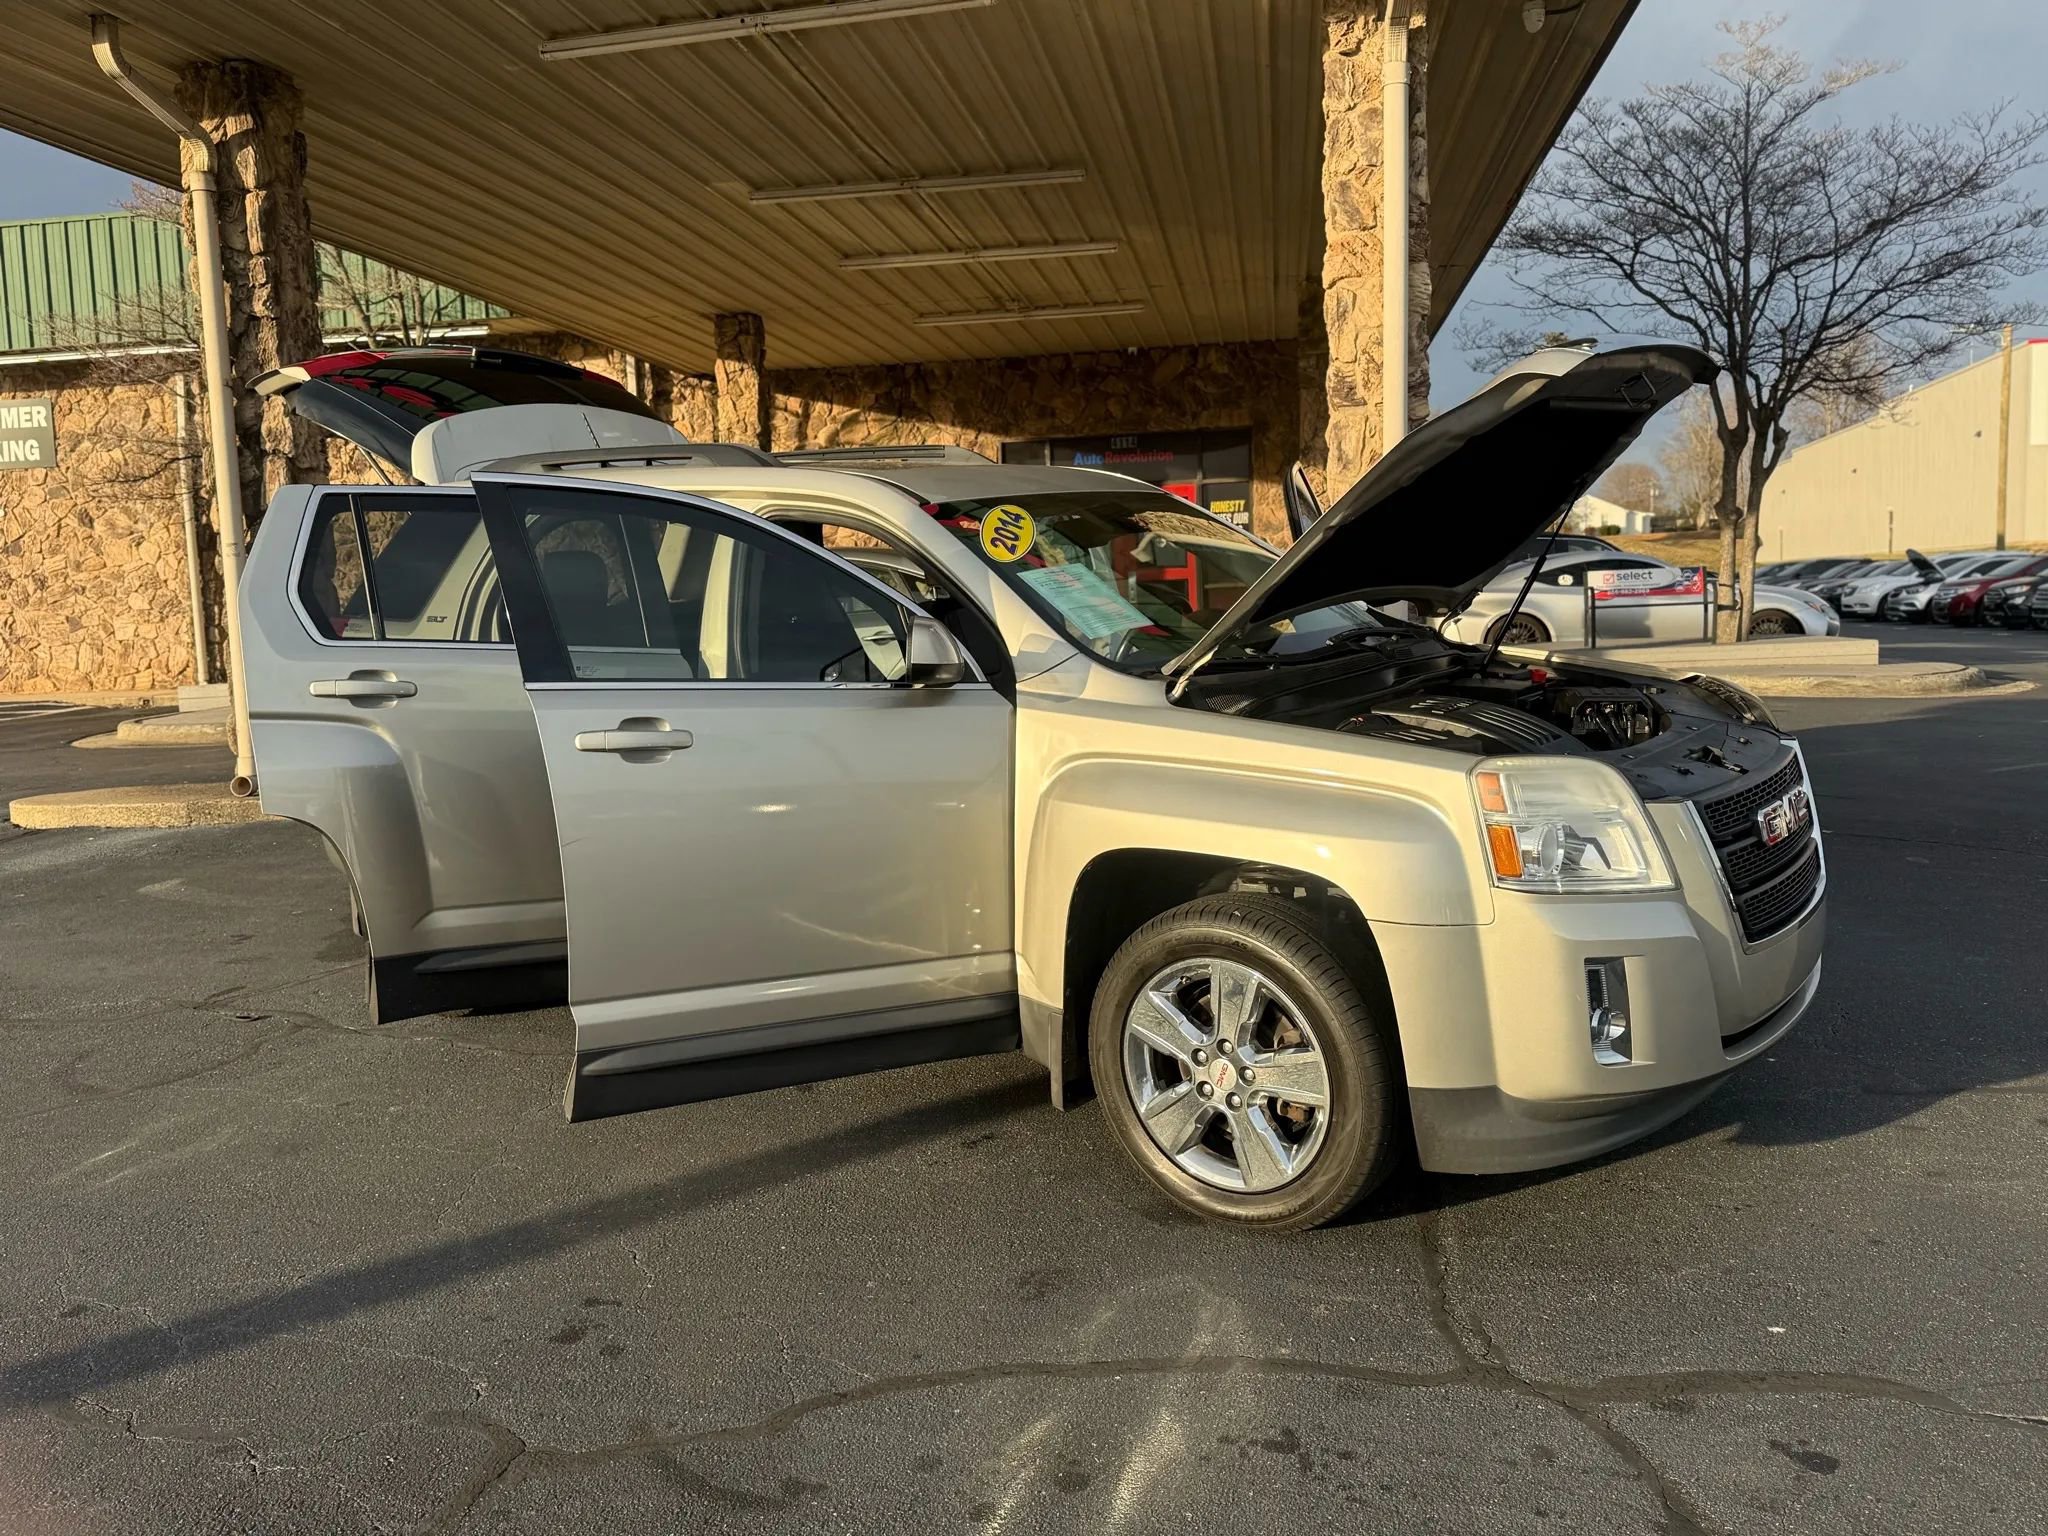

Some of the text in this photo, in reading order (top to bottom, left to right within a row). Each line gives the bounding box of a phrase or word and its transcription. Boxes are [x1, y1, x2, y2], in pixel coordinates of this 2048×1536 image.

[0, 406, 47, 429] MER
[0, 439, 40, 462] ING
[1210, 500, 1245, 513] HONESTY
[1232, 512, 1249, 525] OUR
[990, 508, 1028, 556] 2014
[1616, 570, 1654, 582] select
[426, 615, 448, 623] SLT
[1758, 786, 1810, 847] GMC
[1216, 1062, 1229, 1089] GMC
